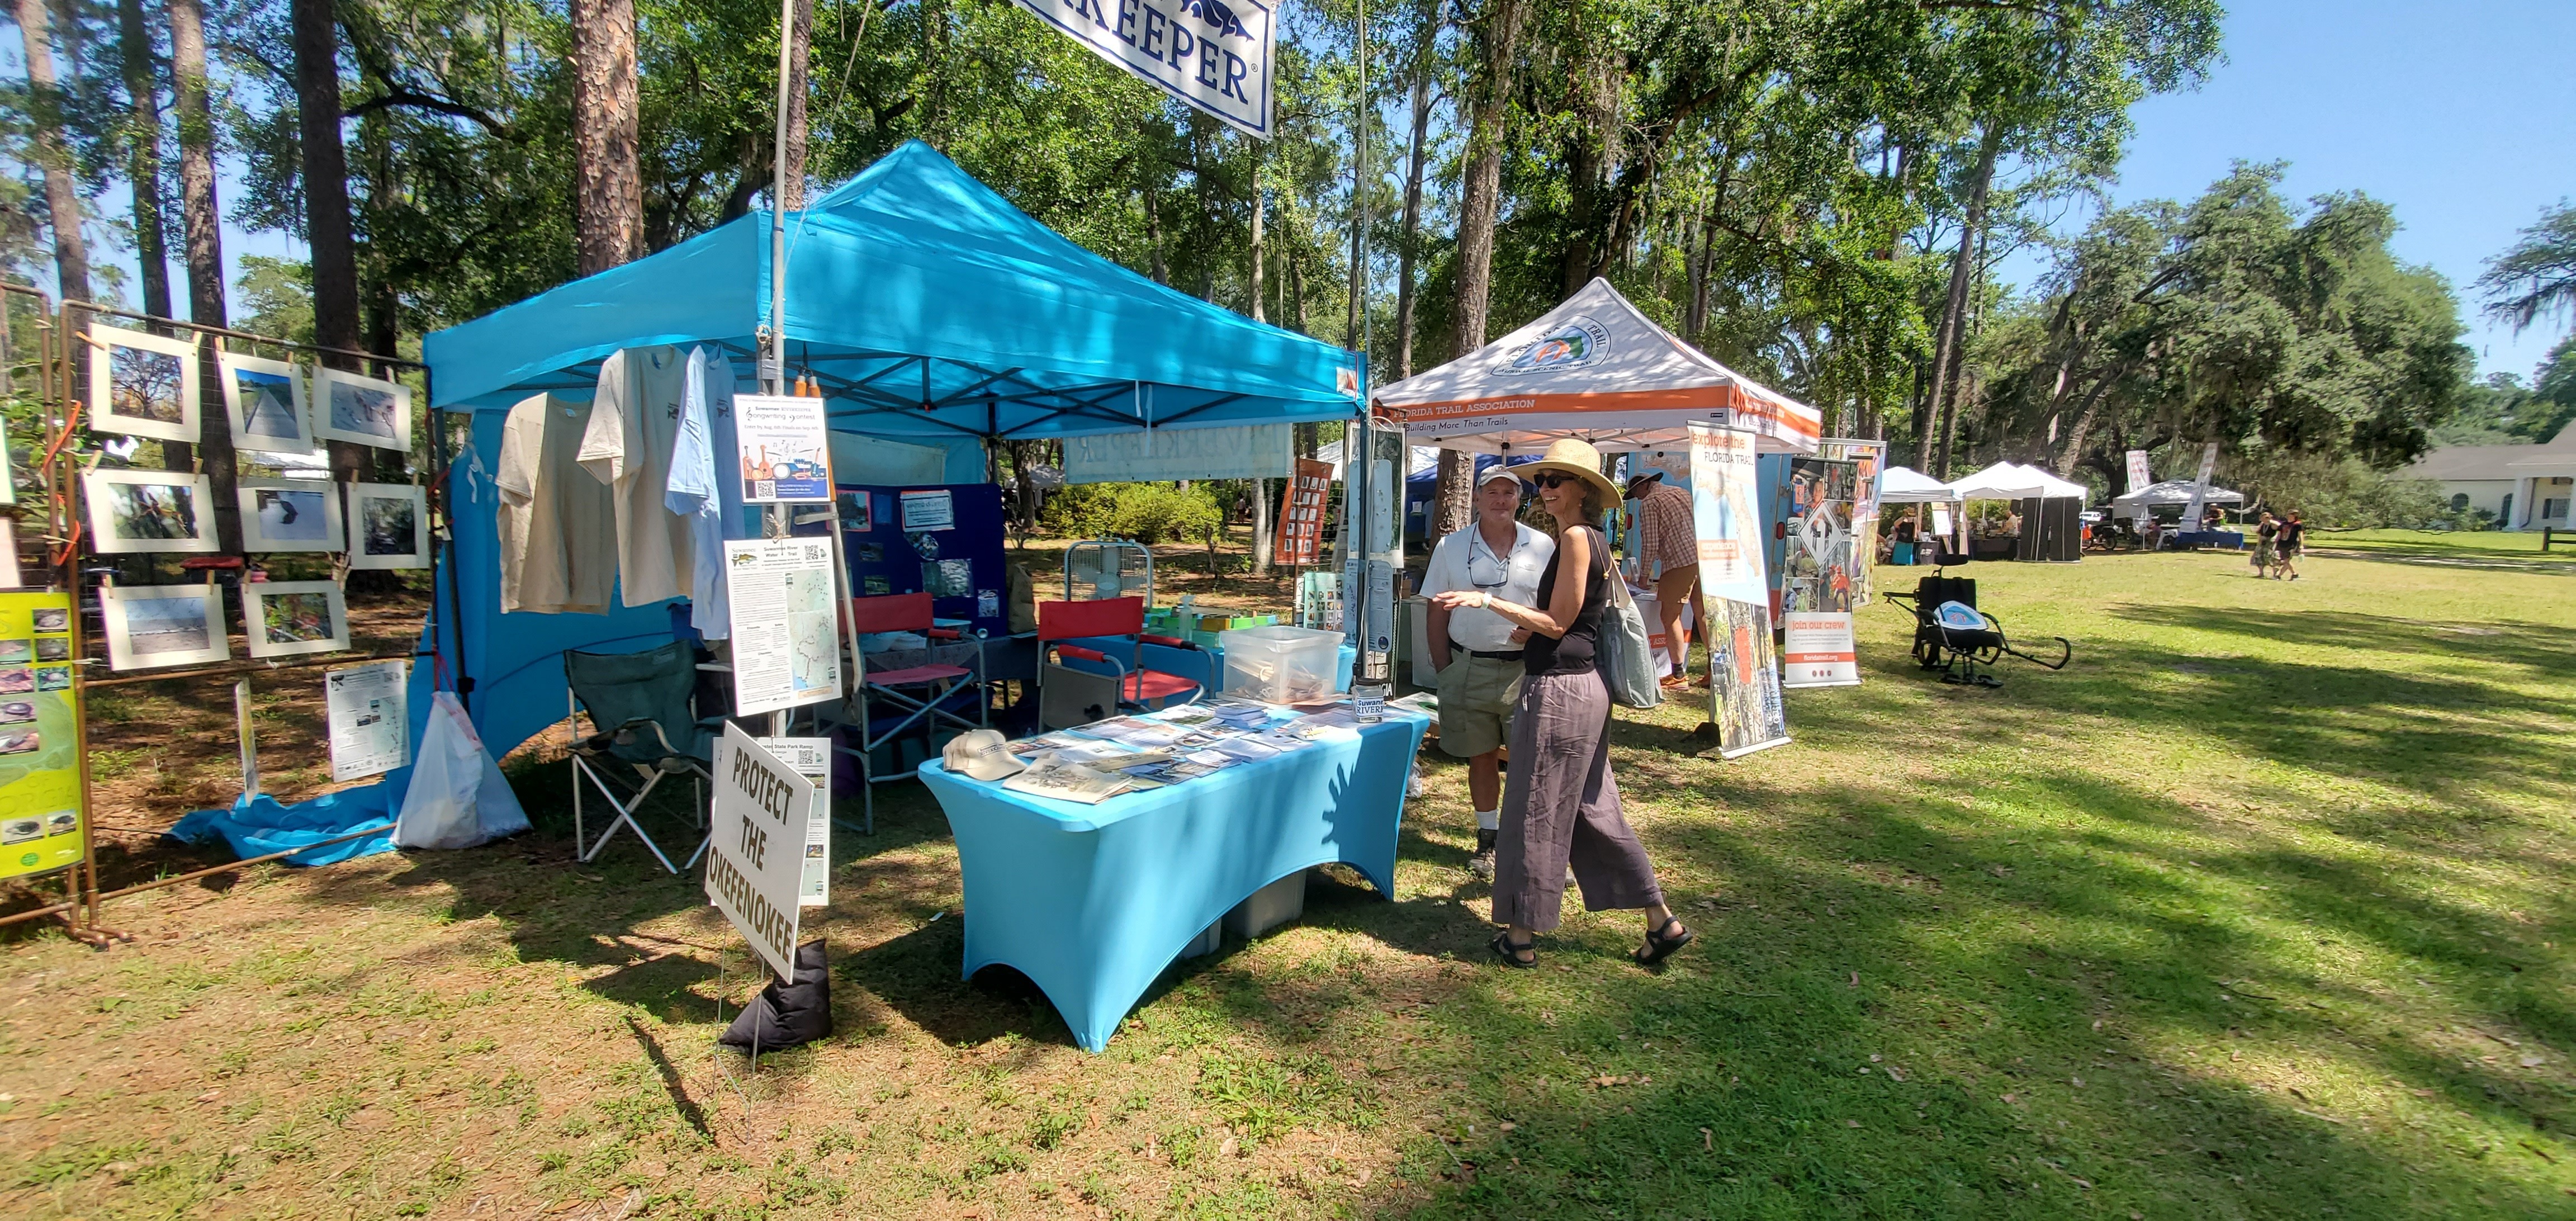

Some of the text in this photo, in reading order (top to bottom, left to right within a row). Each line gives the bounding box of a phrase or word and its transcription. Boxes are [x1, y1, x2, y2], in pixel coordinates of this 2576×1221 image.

[1587, 324, 1606, 348] TRAIL
[1394, 399, 1535, 418] FLORIDA TRAIL ASSOCIATION
[1405, 417, 1508, 432] Building More Than Trails
[1693, 433, 1745, 449] explore the
[1704, 452, 1754, 466] FLORIDA TRAIL
[1792, 621, 1807, 631] join
[732, 746, 793, 826] PROTECT
[740, 813, 767, 872] THE
[709, 846, 793, 964] OKEFENOKEE
